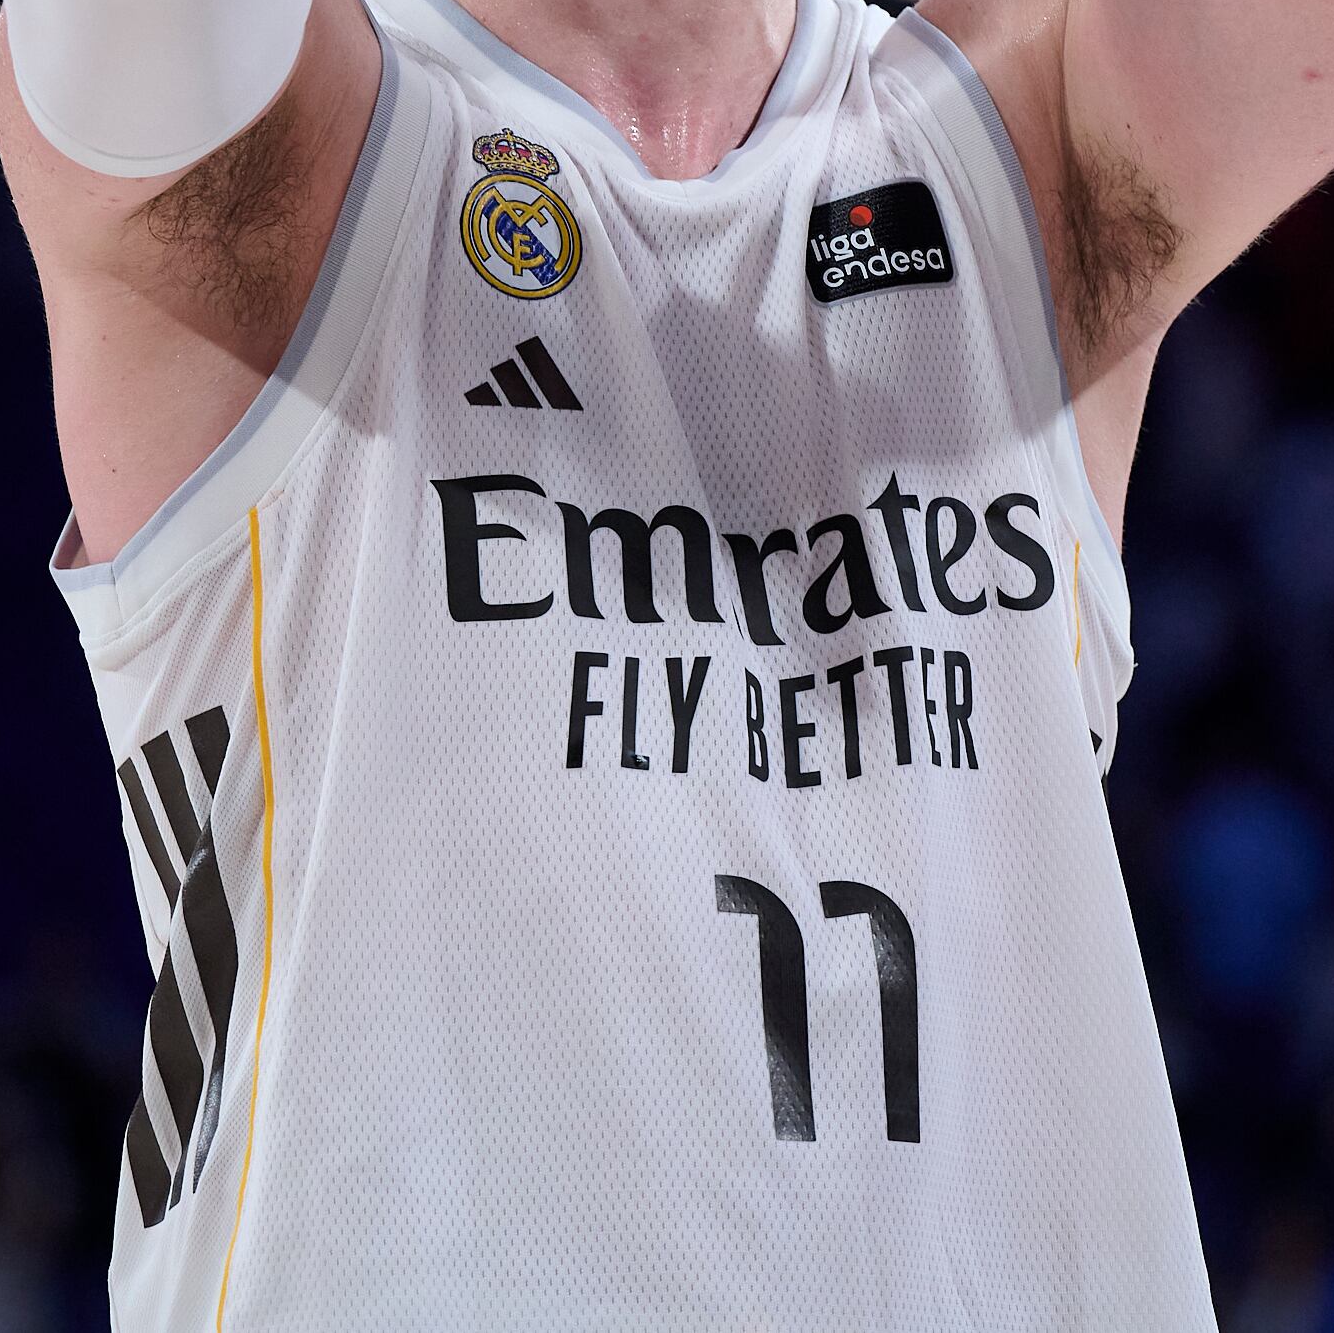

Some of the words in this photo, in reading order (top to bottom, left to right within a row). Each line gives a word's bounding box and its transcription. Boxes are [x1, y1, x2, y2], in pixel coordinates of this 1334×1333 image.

[810, 227, 875, 262] liga
[822, 247, 945, 288] endesa
[429, 471, 1056, 646] Emrates
[566, 651, 712, 774] FLY
[744, 645, 979, 789] BETTER
[714, 874, 921, 1143] 11
